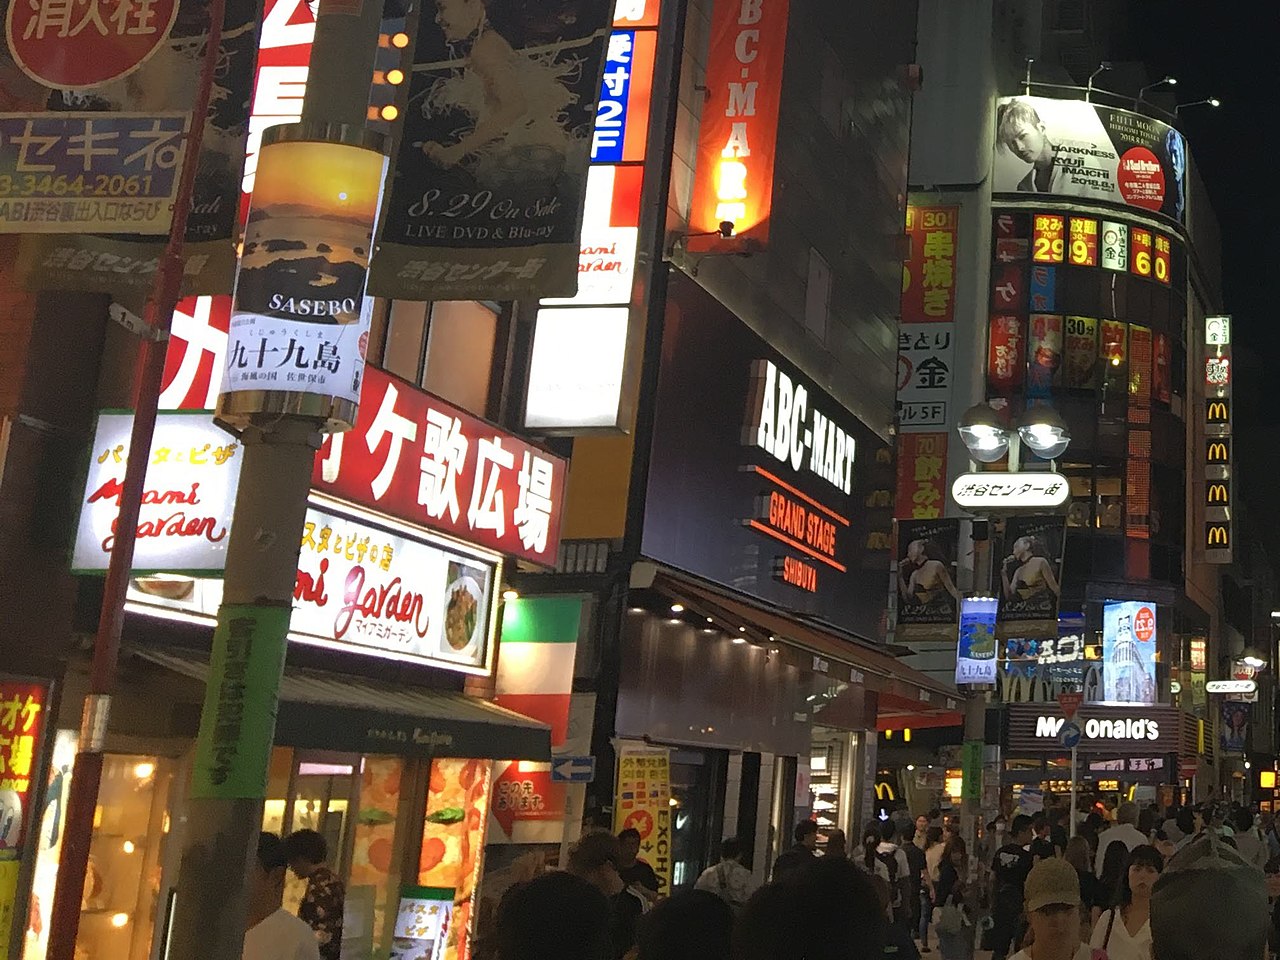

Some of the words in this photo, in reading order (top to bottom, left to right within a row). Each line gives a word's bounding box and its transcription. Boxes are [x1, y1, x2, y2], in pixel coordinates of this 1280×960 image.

[408, 189, 492, 219] 8.29
[406, 224, 446, 238] LIVE
[453, 226, 488, 239] DVD
[269, 293, 355, 316] SASEBO
[228, 338, 341, 374] 九十九島
[915, 356, 949, 389] 金
[757, 360, 856, 496] ABC-MART
[98, 443, 238, 466] パタとピザ
[87, 478, 200, 506] Mami
[958, 482, 1062, 497] 渋谷センター街
[769, 491, 806, 541] GRAND
[806, 512, 836, 557] STAGE
[302, 522, 394, 572] スタとピザの店
[783, 556, 817, 592] SHIBUYA
[1036, 717, 1159, 740] Monald's
[499, 780, 533, 793] この先
[497, 794, 545, 811] あります。
